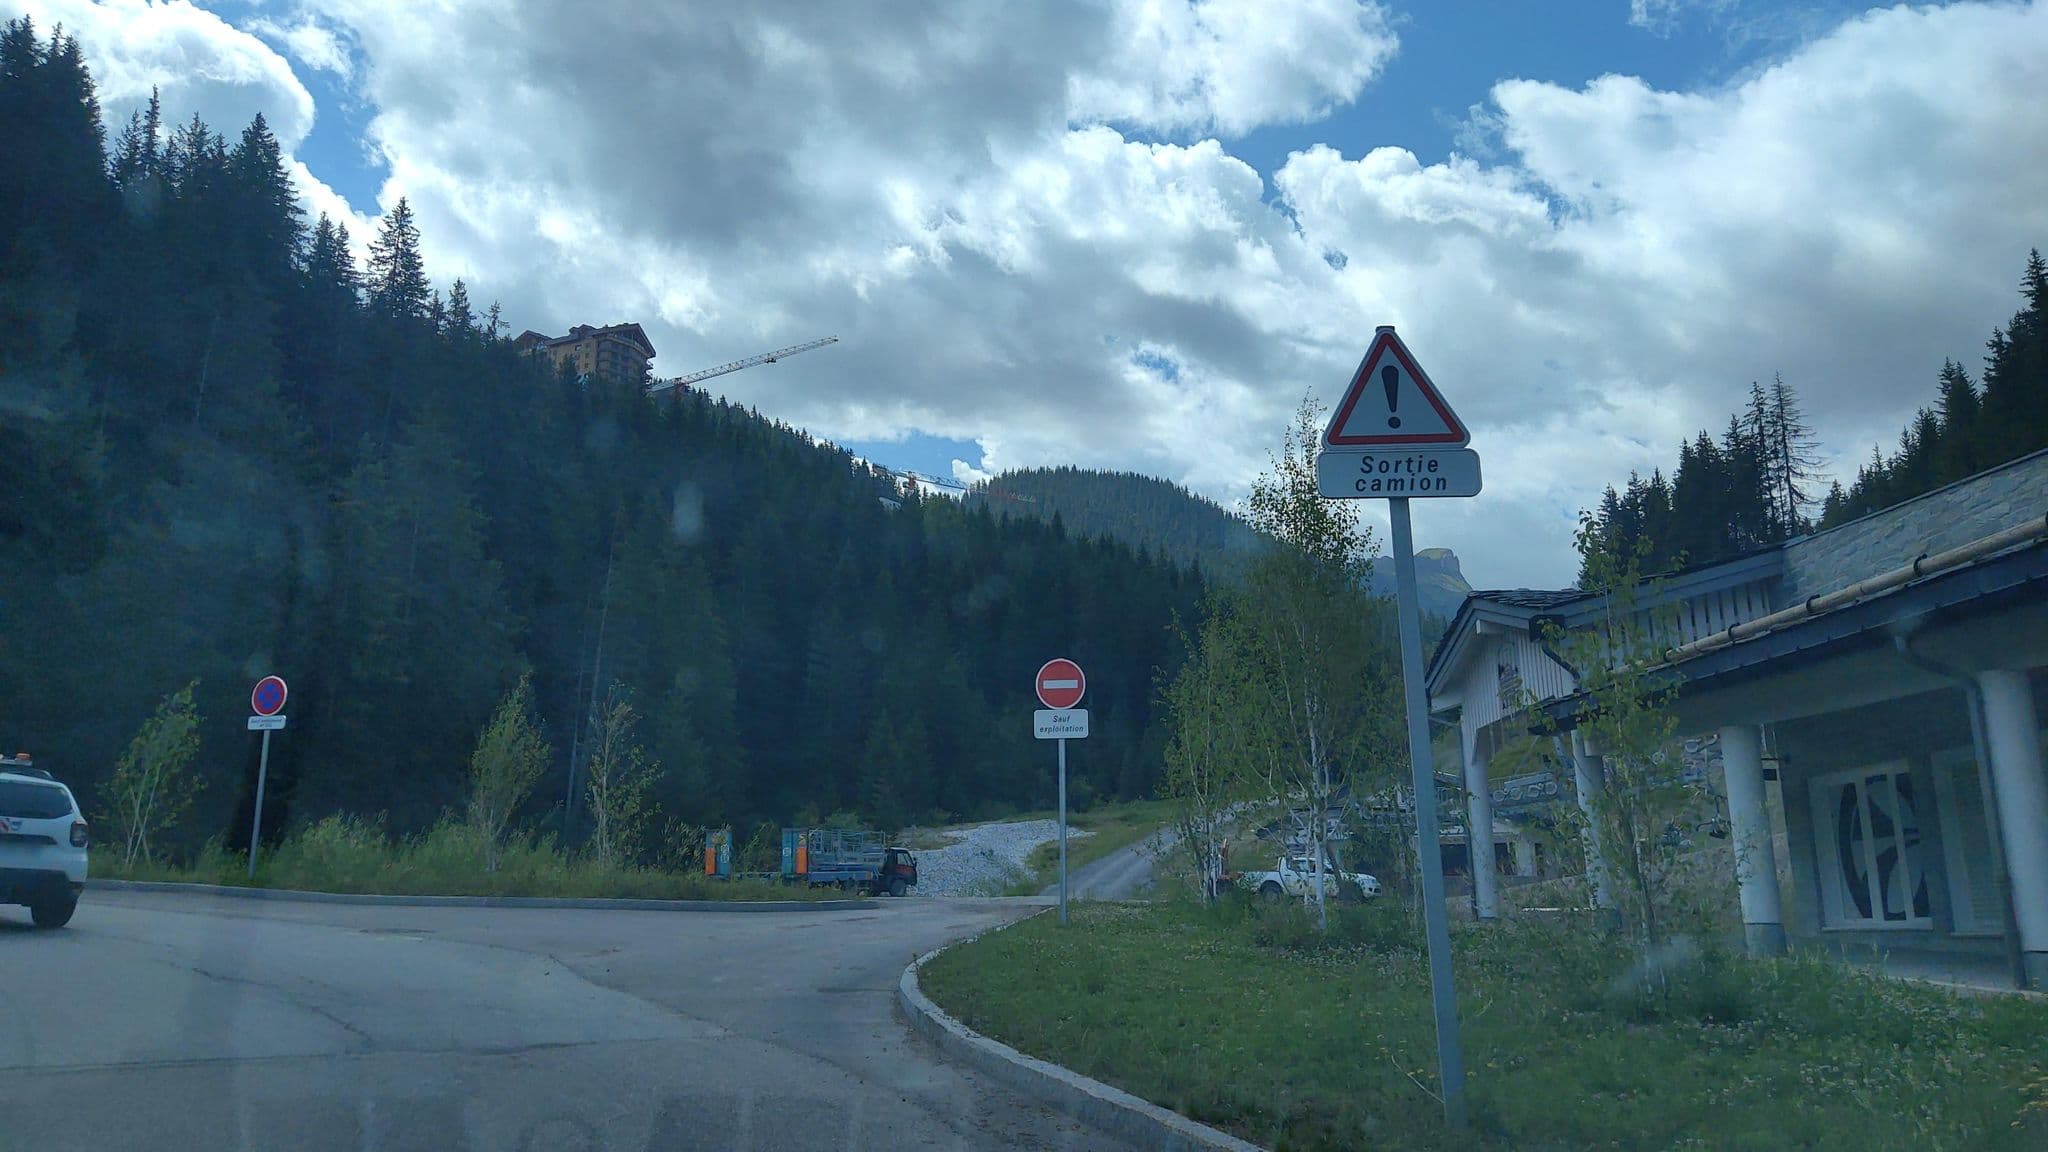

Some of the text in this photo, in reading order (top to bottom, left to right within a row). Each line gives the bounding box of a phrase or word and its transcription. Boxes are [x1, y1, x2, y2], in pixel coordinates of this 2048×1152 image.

[1360, 455, 1439, 474] Sortie
[1355, 473, 1447, 492] camion
[1053, 715, 1071, 723] Sauf
[1039, 726, 1084, 734] exploitation
